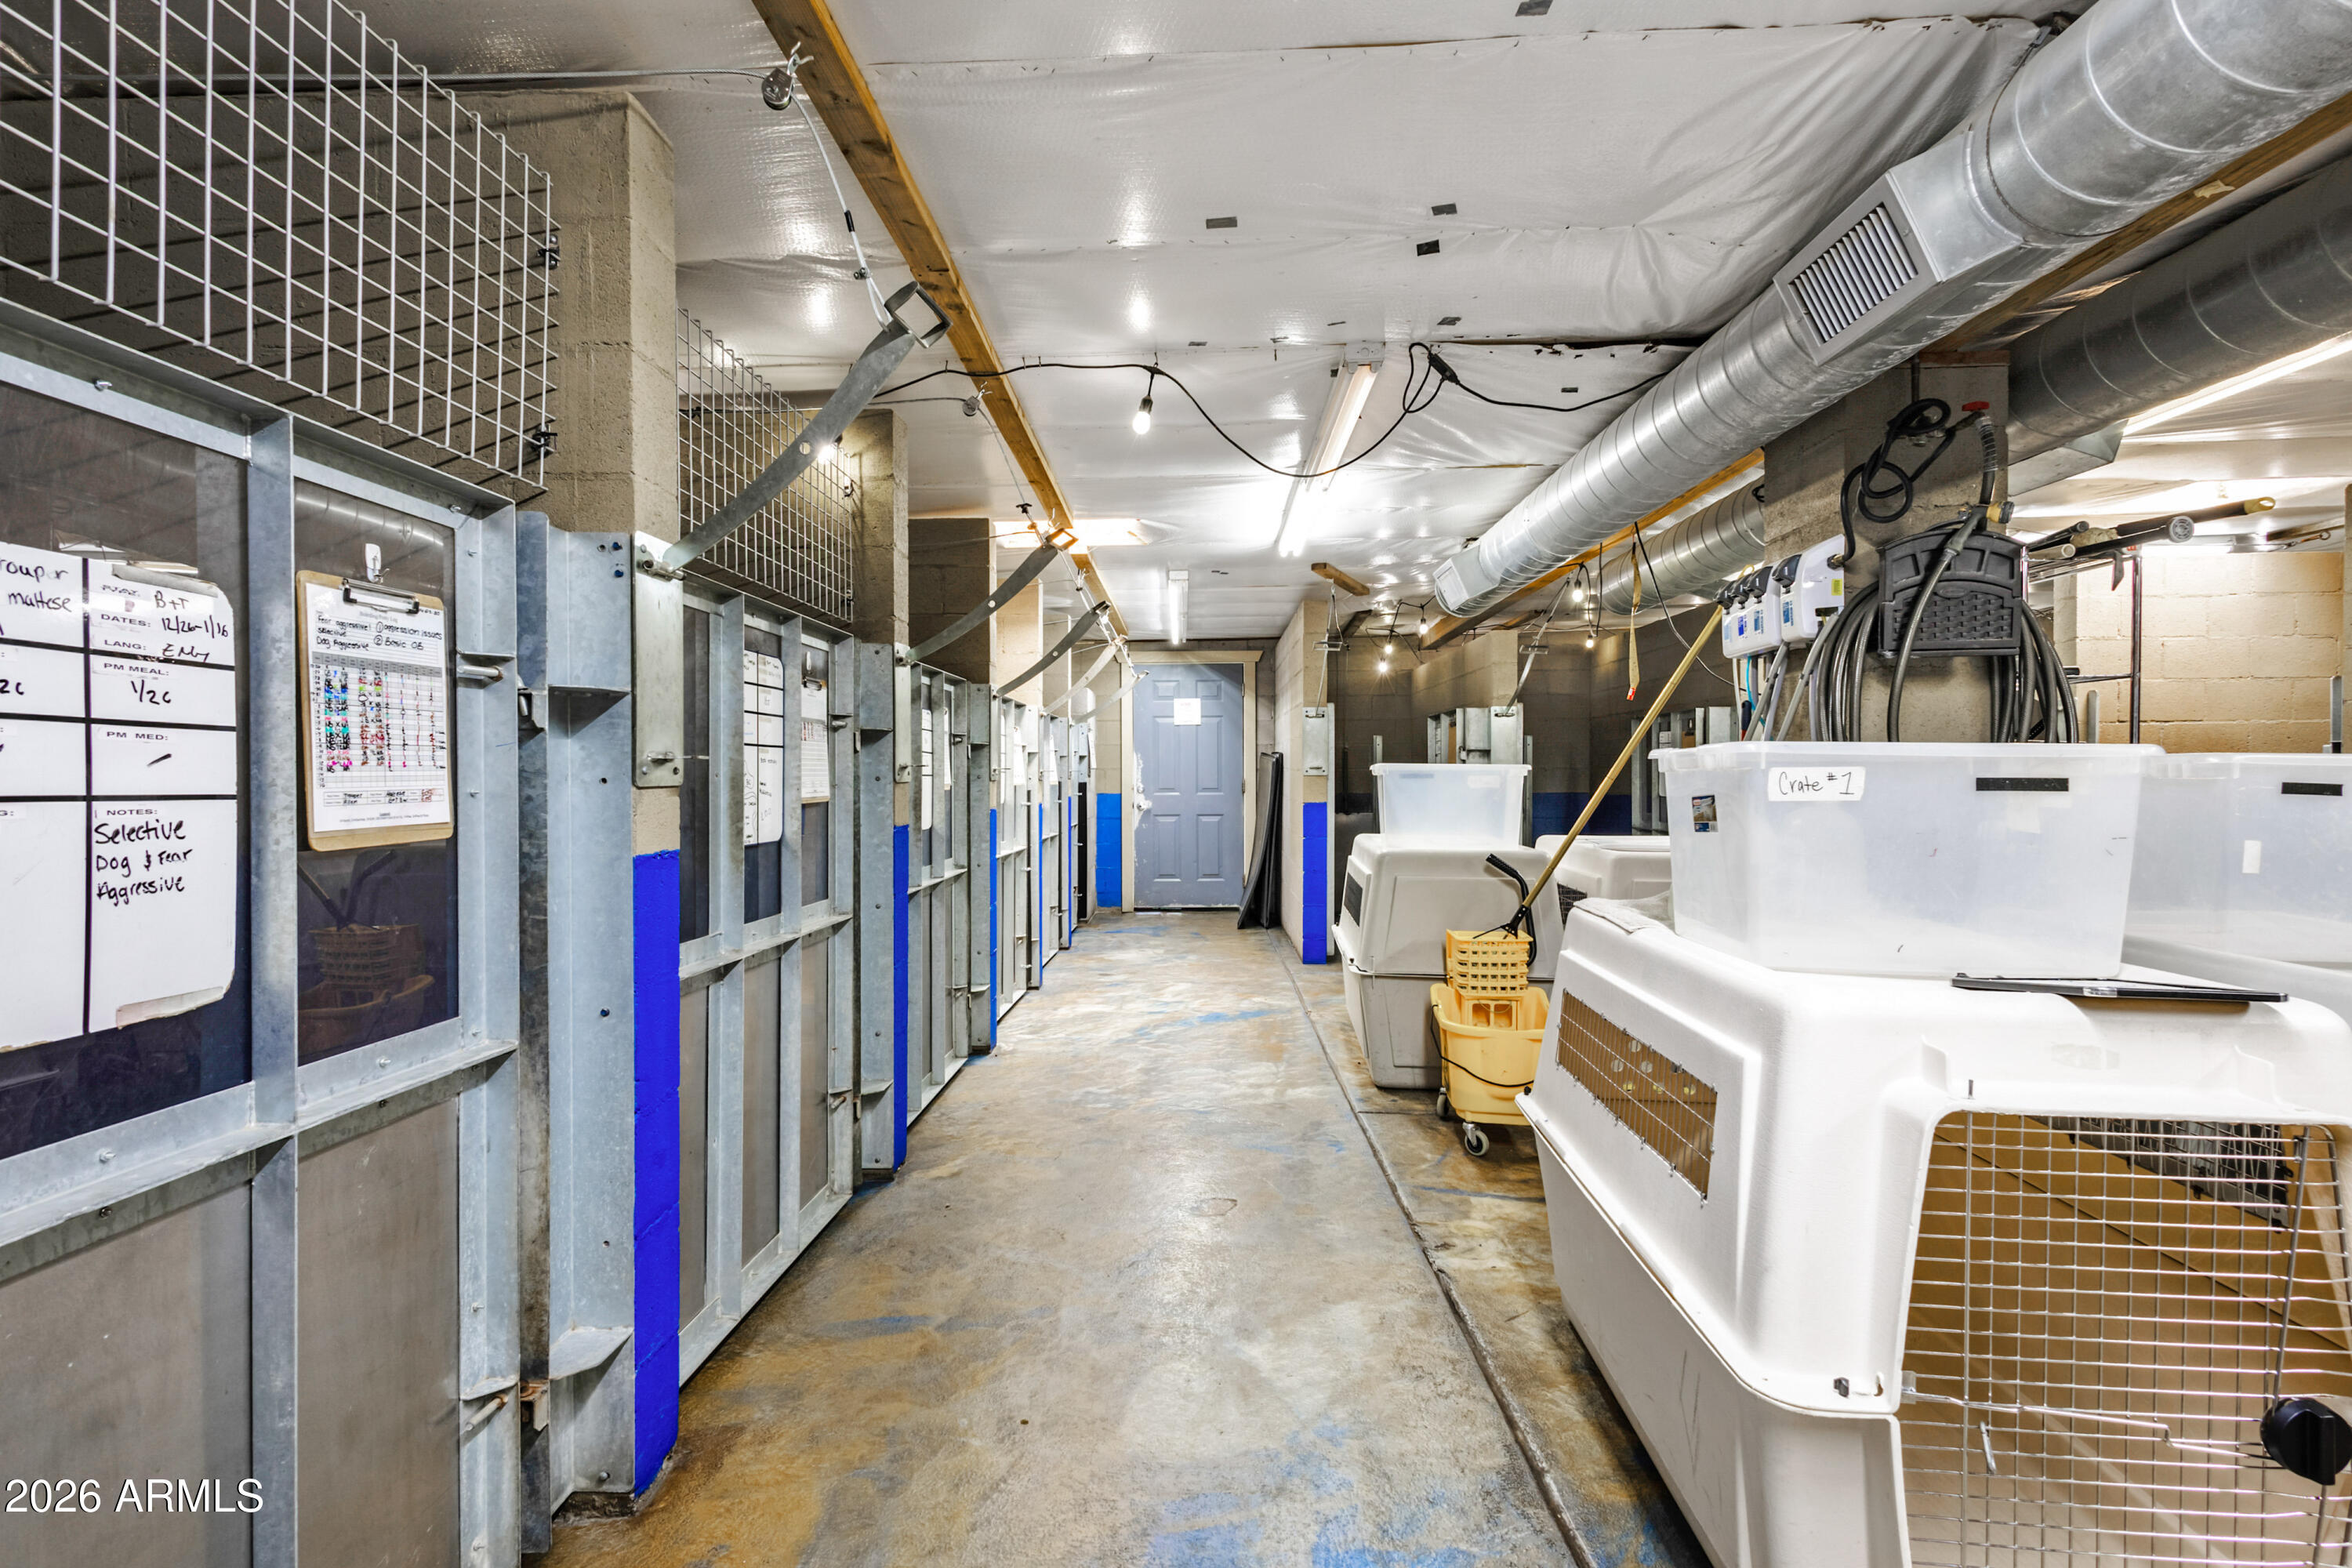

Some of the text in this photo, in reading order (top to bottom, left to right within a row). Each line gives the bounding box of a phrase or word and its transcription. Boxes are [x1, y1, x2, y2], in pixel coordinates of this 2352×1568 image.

[100, 614, 151, 627] DATES:
[104, 639, 147, 650] LANG:
[103, 662, 169, 677] PM MEAL:
[135, 732, 169, 741] MED:
[1779, 771, 1823, 795] Crate
[94, 819, 187, 845] Selective
[96, 855, 131, 878] Dog
[96, 876, 185, 907] Aggressive
